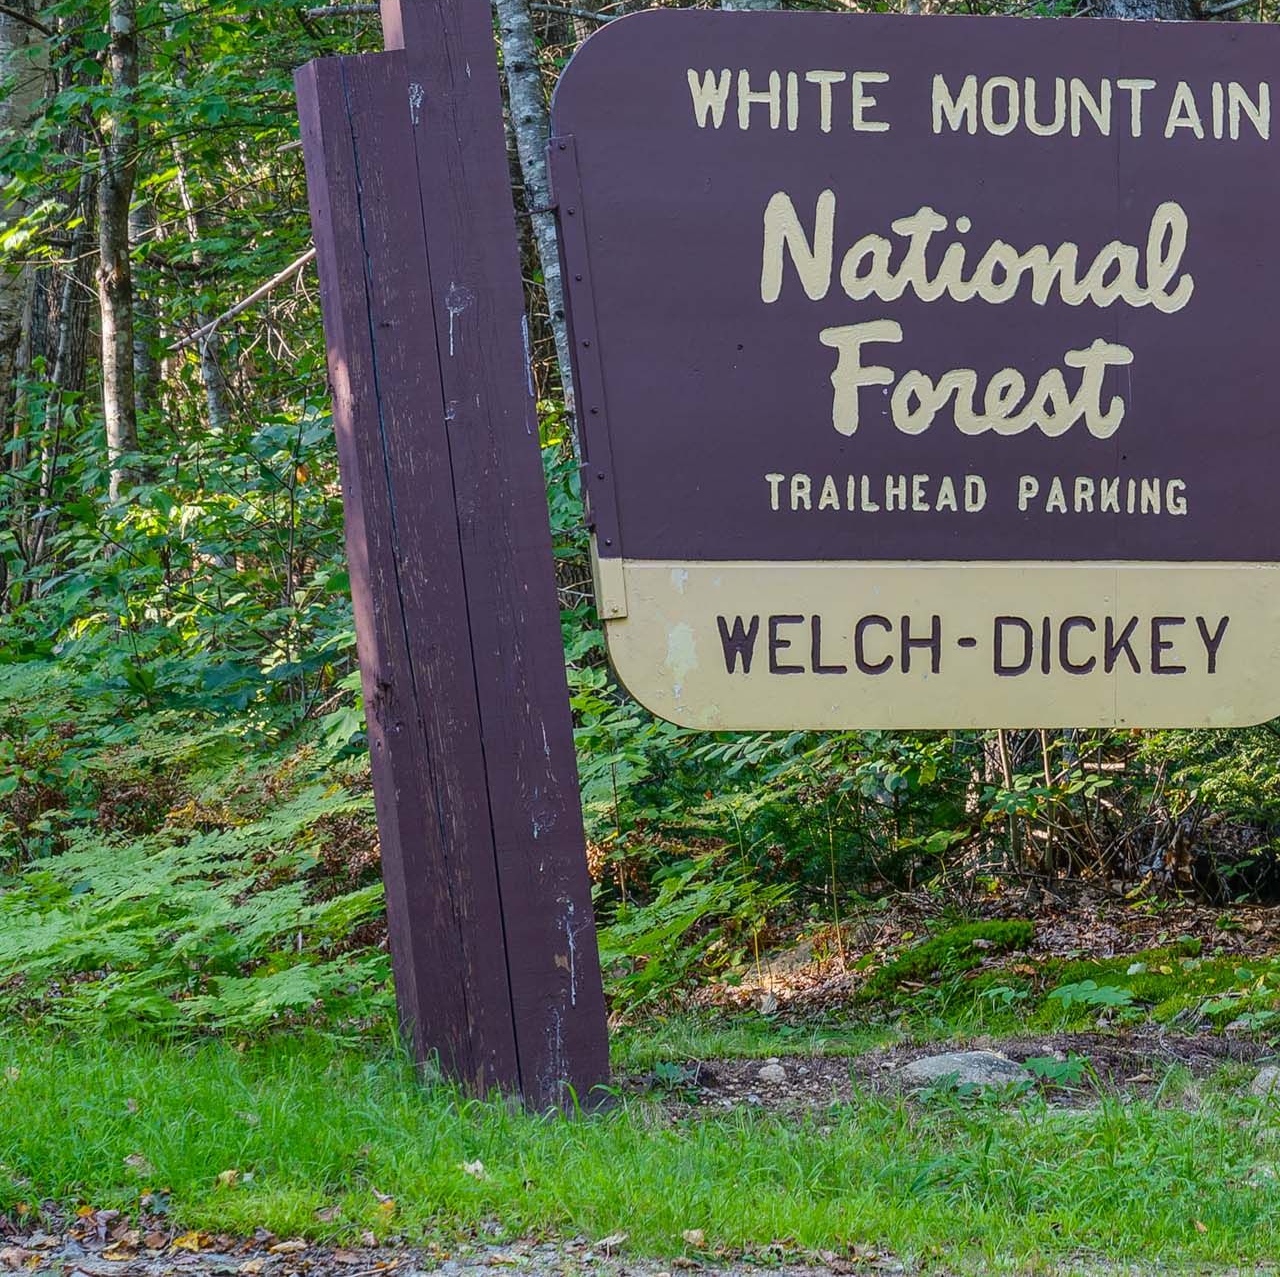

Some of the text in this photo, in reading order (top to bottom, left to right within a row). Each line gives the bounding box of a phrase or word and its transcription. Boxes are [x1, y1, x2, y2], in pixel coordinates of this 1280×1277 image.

[686, 68, 1272, 141] WHITE MOUNTAIN
[760, 188, 1195, 314] National
[819, 319, 1135, 440] Forest
[764, 472, 1188, 516] TRAILHEAD PARKING
[716, 614, 1231, 677] WELCH-DICKEY
